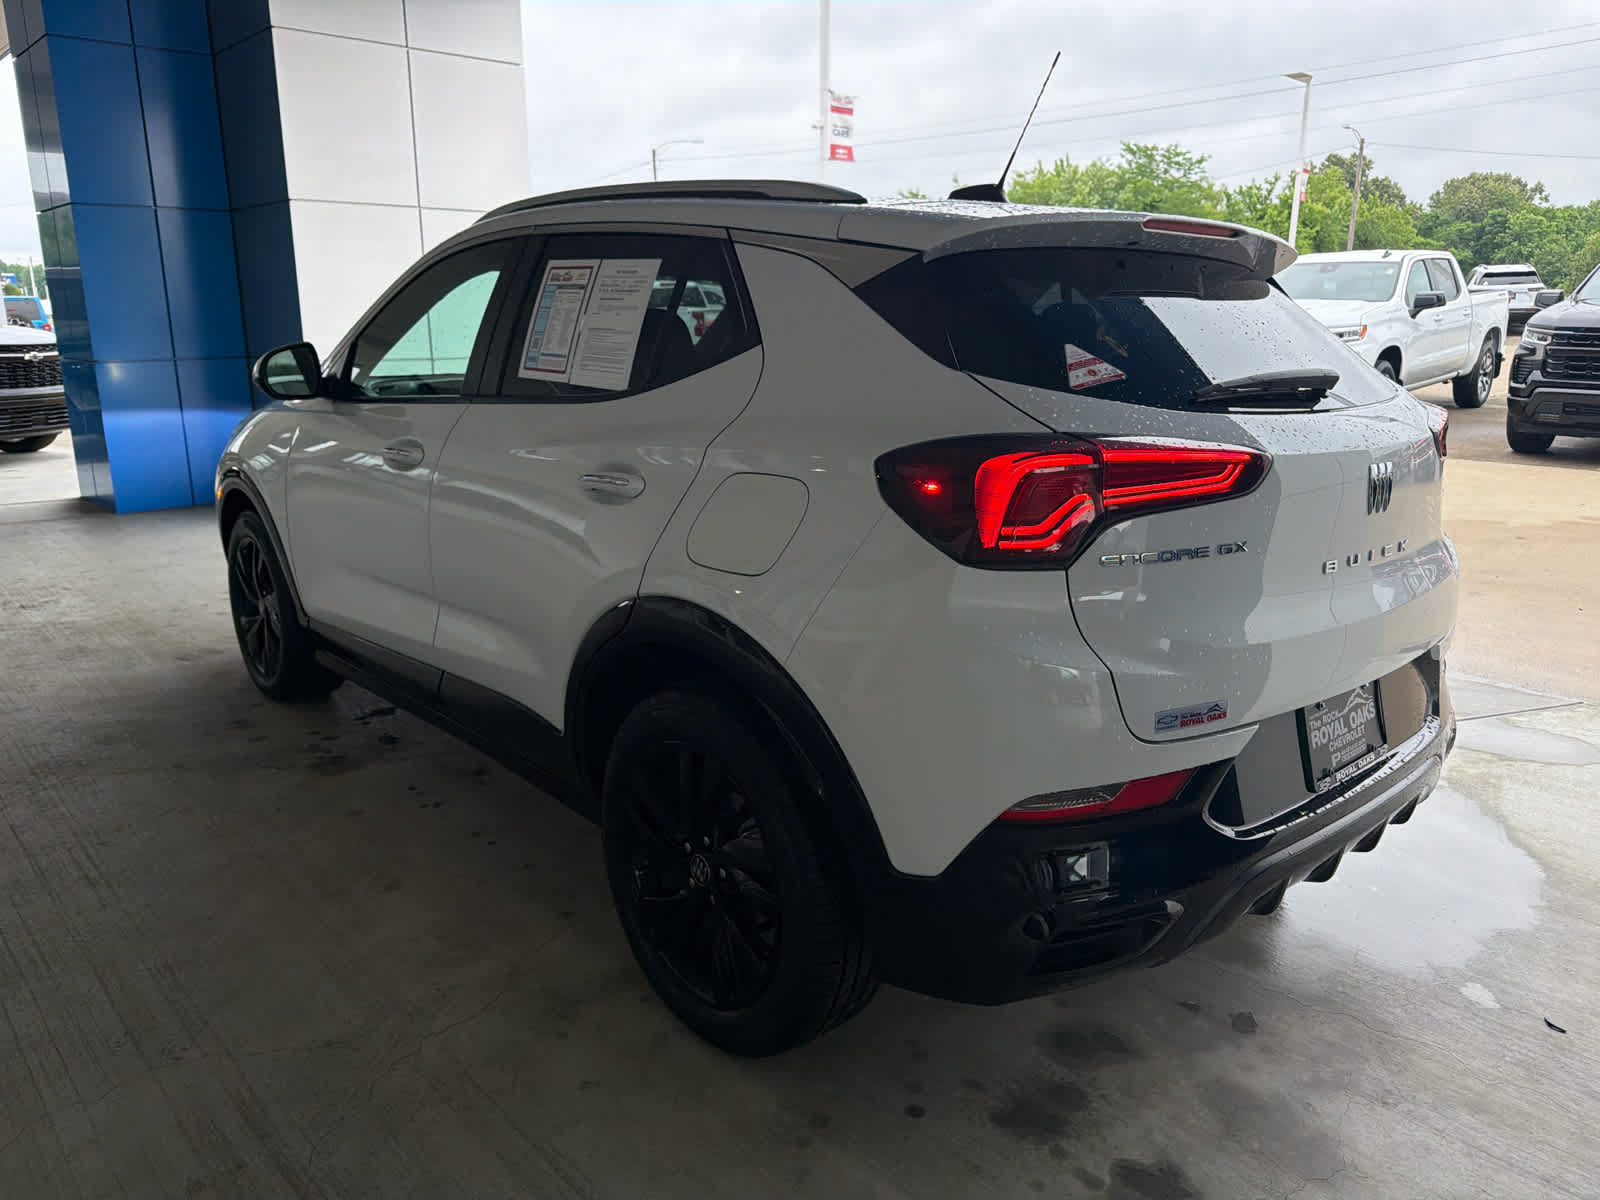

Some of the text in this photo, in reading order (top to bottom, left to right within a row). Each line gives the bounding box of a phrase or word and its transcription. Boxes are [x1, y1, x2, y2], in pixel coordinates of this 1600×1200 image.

[1098, 541, 1249, 567] ENCORE GX
[1322, 538, 1409, 575] BUICK
[1180, 716, 1205, 727] ROYAL
[1206, 711, 1227, 722] OAKS
[1311, 701, 1376, 749] ROYAL OAKS
[1329, 724, 1366, 752] CHEVROLET
[1335, 765, 1357, 782] ROYAL
[1358, 753, 1376, 768] OAKS
